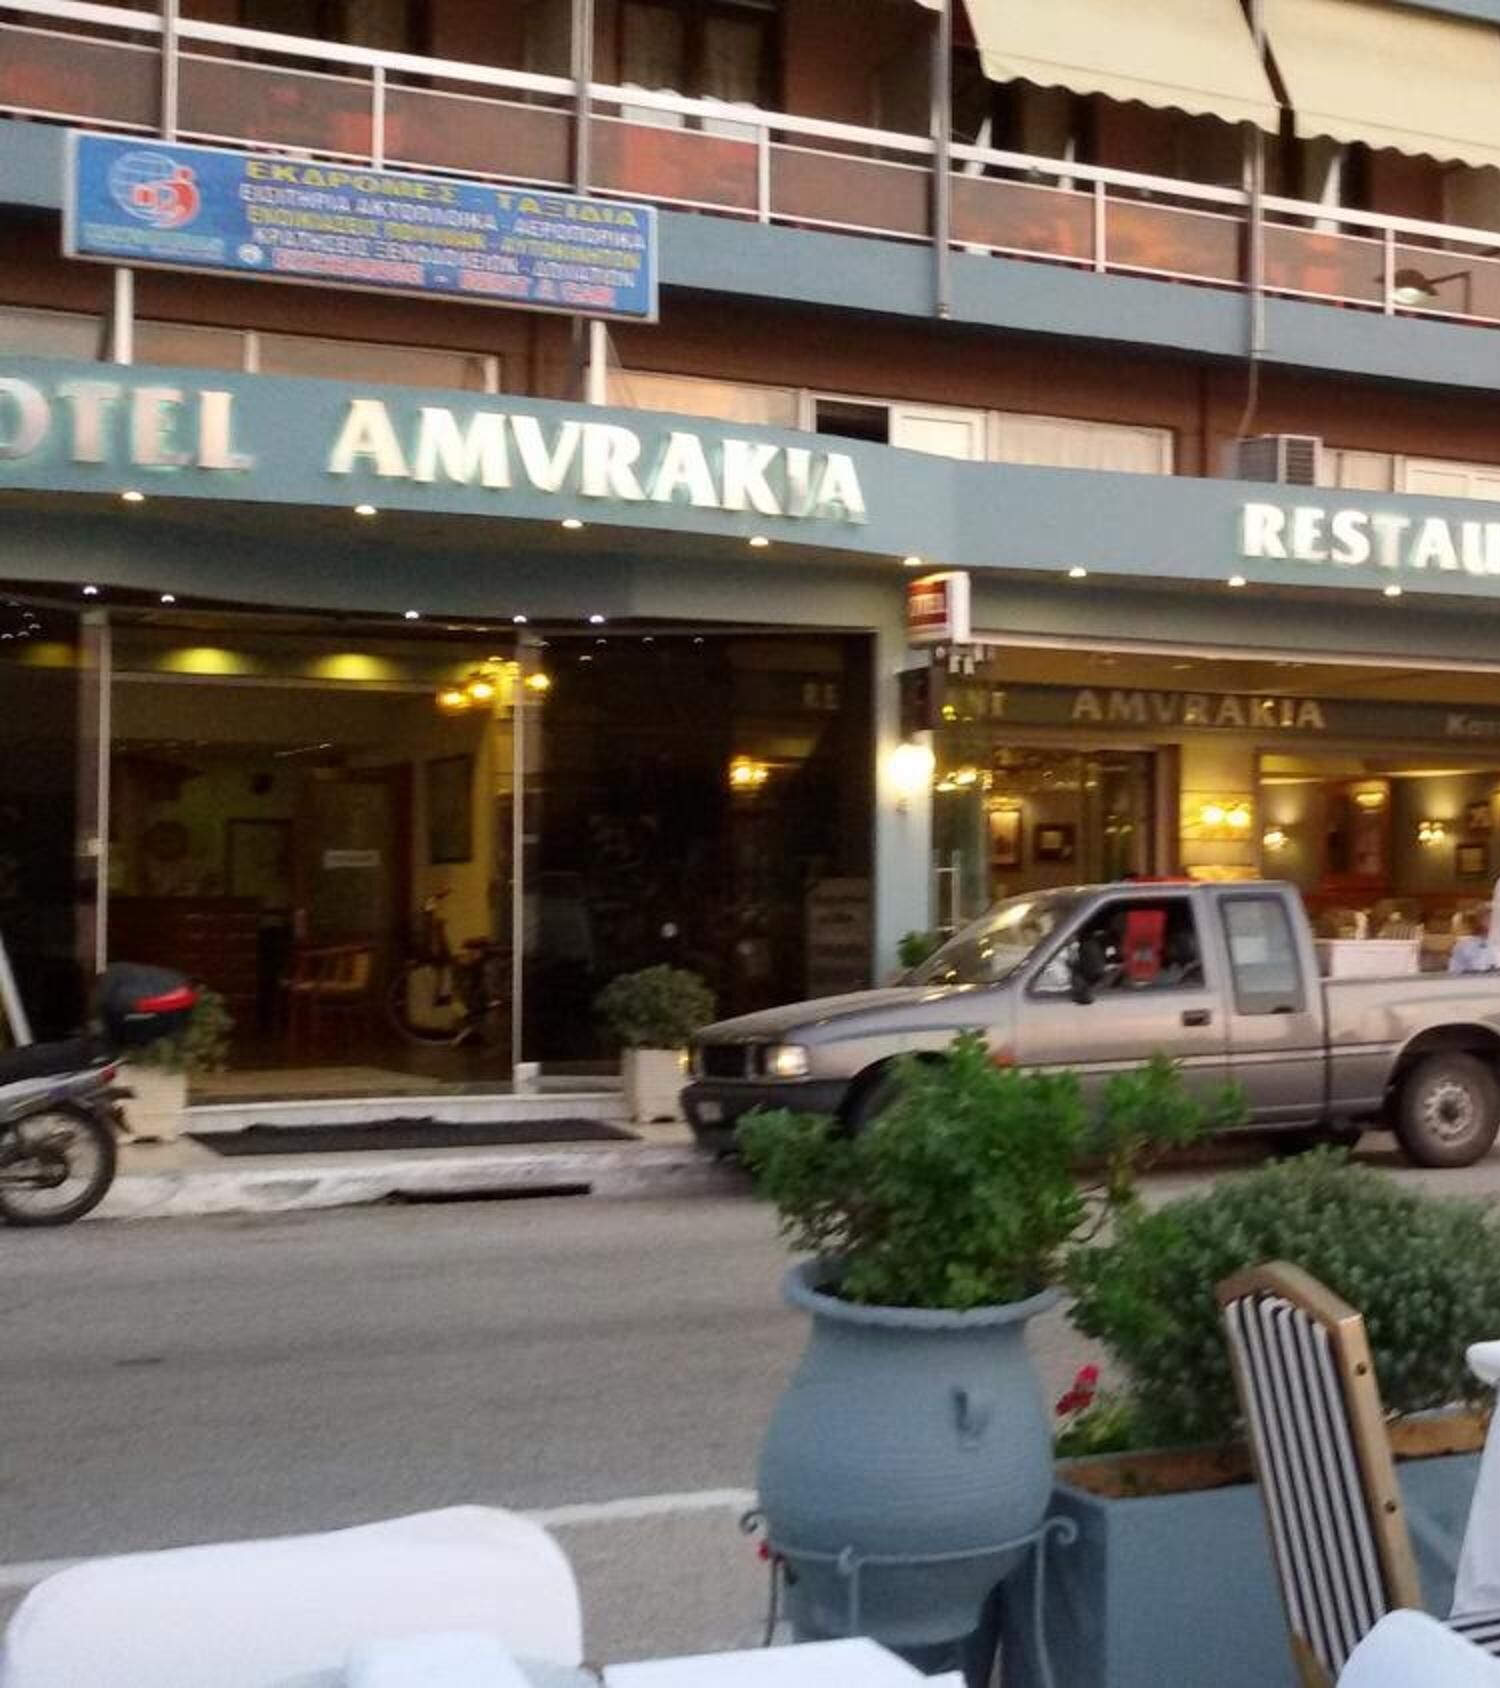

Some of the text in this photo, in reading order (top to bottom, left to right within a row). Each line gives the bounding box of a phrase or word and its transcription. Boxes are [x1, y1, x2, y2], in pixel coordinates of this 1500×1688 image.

[497, 193, 639, 226] ΤΑΞΙΔΙΑ
[329, 399, 867, 524] AMVRAKIA
[1071, 688, 1326, 730] AMVRAKIA
